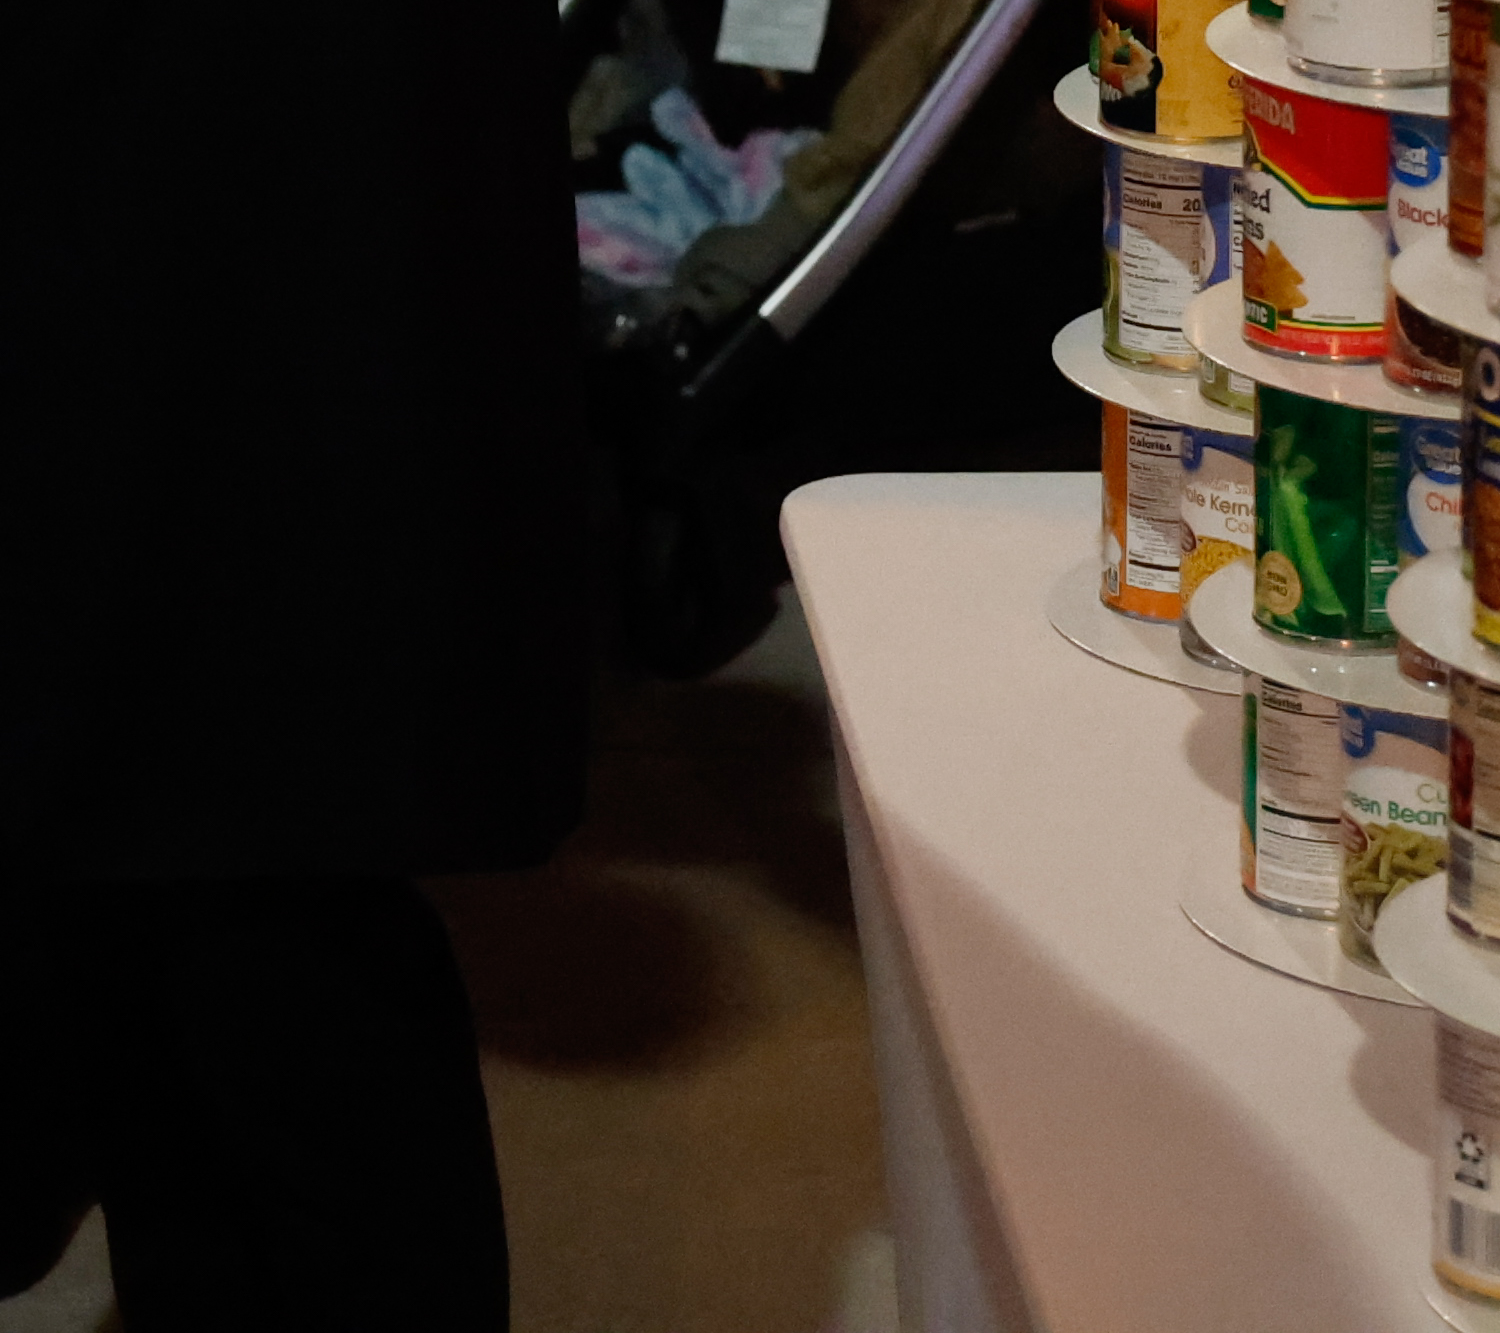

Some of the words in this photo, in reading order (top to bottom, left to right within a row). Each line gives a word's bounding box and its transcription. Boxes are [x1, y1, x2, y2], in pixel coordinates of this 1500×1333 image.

[1123, 194, 1163, 210] Calories
[1129, 435, 1172, 452] Calories
[1186, 488, 1206, 508] ole
[1210, 494, 1254, 517] Kern
[1225, 517, 1252, 533] Co
[1417, 783, 1447, 804] Cu
[1345, 790, 1382, 816] een
[1388, 800, 1447, 826] Bean
